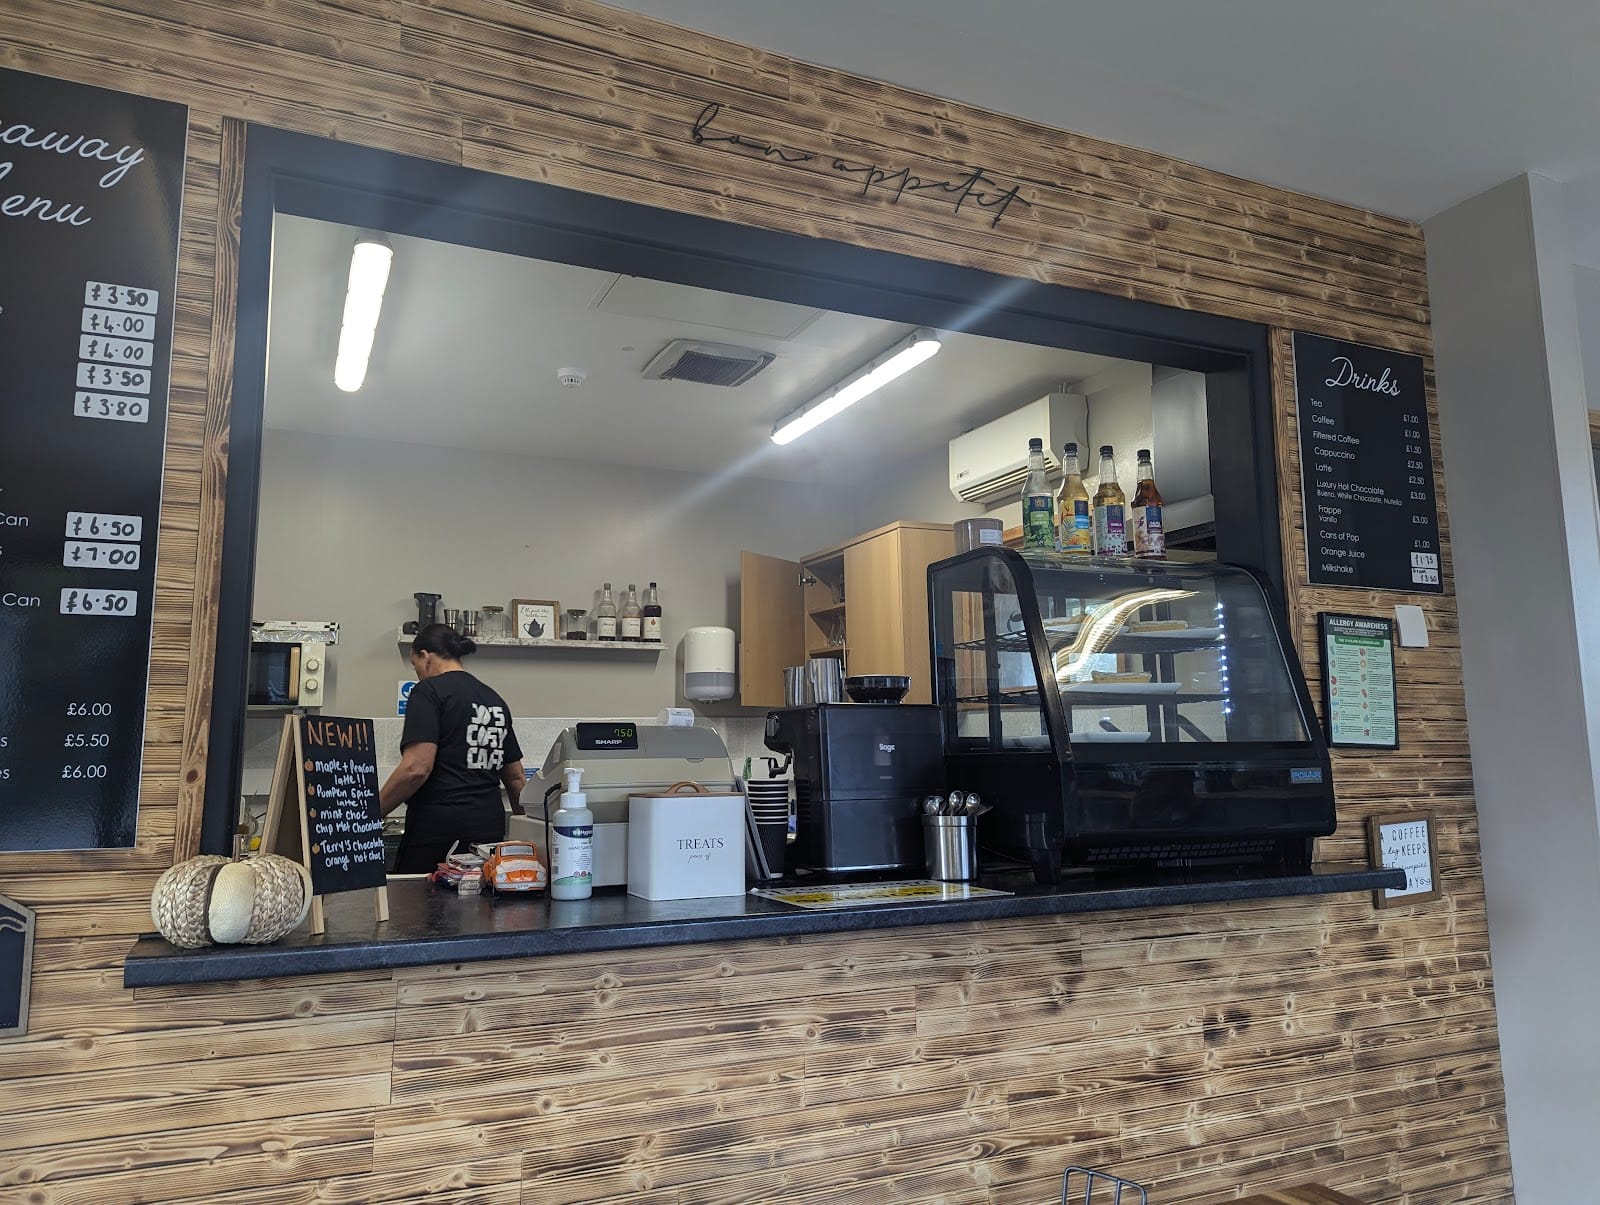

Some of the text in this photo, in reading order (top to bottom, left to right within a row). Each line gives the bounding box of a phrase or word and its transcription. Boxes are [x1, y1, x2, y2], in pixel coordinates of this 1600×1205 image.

[0, 121, 144, 188] away
[832, 158, 1033, 229] appetit
[92, 284, 149, 307] £3.50
[90, 313, 145, 333] £4.00
[88, 340, 144, 360] £4.00
[87, 365, 144, 387] £3.50
[1325, 356, 1400, 396] Drinks
[82, 395, 142, 416] £3.80
[1311, 398, 1419, 424] Tea £1.00
[1312, 415, 1420, 439] Coffee £1.00
[1313, 430, 1422, 454] Filtered Coffee £1.50
[1314, 446, 1355, 460] Cappuccino
[1315, 463, 1332, 473] Latte
[1316, 480, 1336, 491] Luxury
[1337, 482, 1349, 491] Hot
[1350, 483, 1385, 496] Chocolate
[1337, 491, 1352, 500] White
[1383, 497, 1402, 506] Nutella
[1318, 504, 1342, 516] Frappe
[73, 516, 135, 536] £6.50
[1319, 514, 1338, 524] Vanilla
[1320, 530, 1337, 540] Cans
[1338, 532, 1345, 541] of
[1346, 532, 1360, 543] Pop
[71, 546, 137, 565] £7.00
[1320, 546, 1366, 559] Orange Juice
[1321, 563, 1354, 574] Milkshake
[2, 592, 41, 607] Can
[66, 590, 128, 612] £6.50
[1329, 618, 1388, 630] ALLERGY AWARENESS
[66, 703, 112, 716] £6.00
[64, 733, 110, 747] £5.50
[307, 720, 369, 752] NEW!!
[466, 723, 508, 749] COSY
[879, 743, 896, 753] Sage
[61, 764, 107, 779] £6.00
[315, 759, 341, 774] Maple
[1392, 826, 1425, 841] COFFEE
[676, 837, 724, 850] TREATS
[1401, 842, 1427, 857] KEEPS
